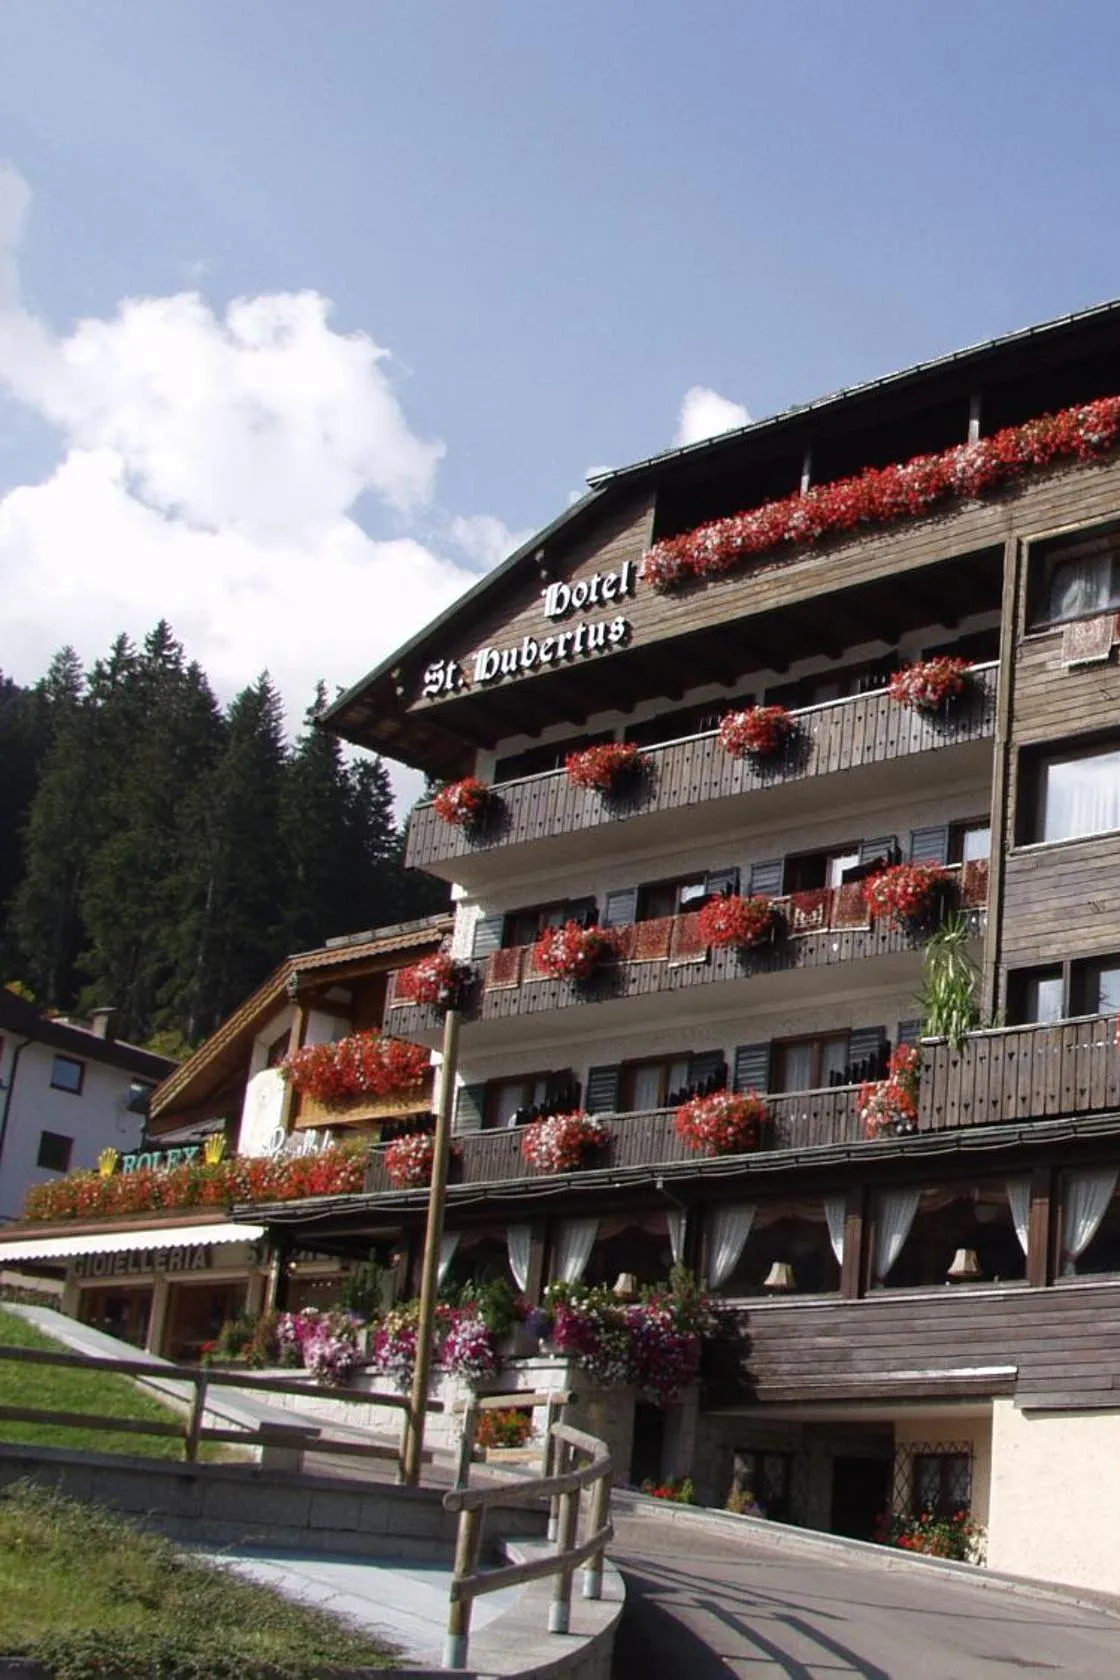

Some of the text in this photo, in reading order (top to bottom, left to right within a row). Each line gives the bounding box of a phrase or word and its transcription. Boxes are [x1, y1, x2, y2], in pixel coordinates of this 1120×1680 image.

[541, 561, 630, 617] Hotel
[422, 616, 626, 696] St. Hubertus
[122, 1145, 200, 1176] ROLEX
